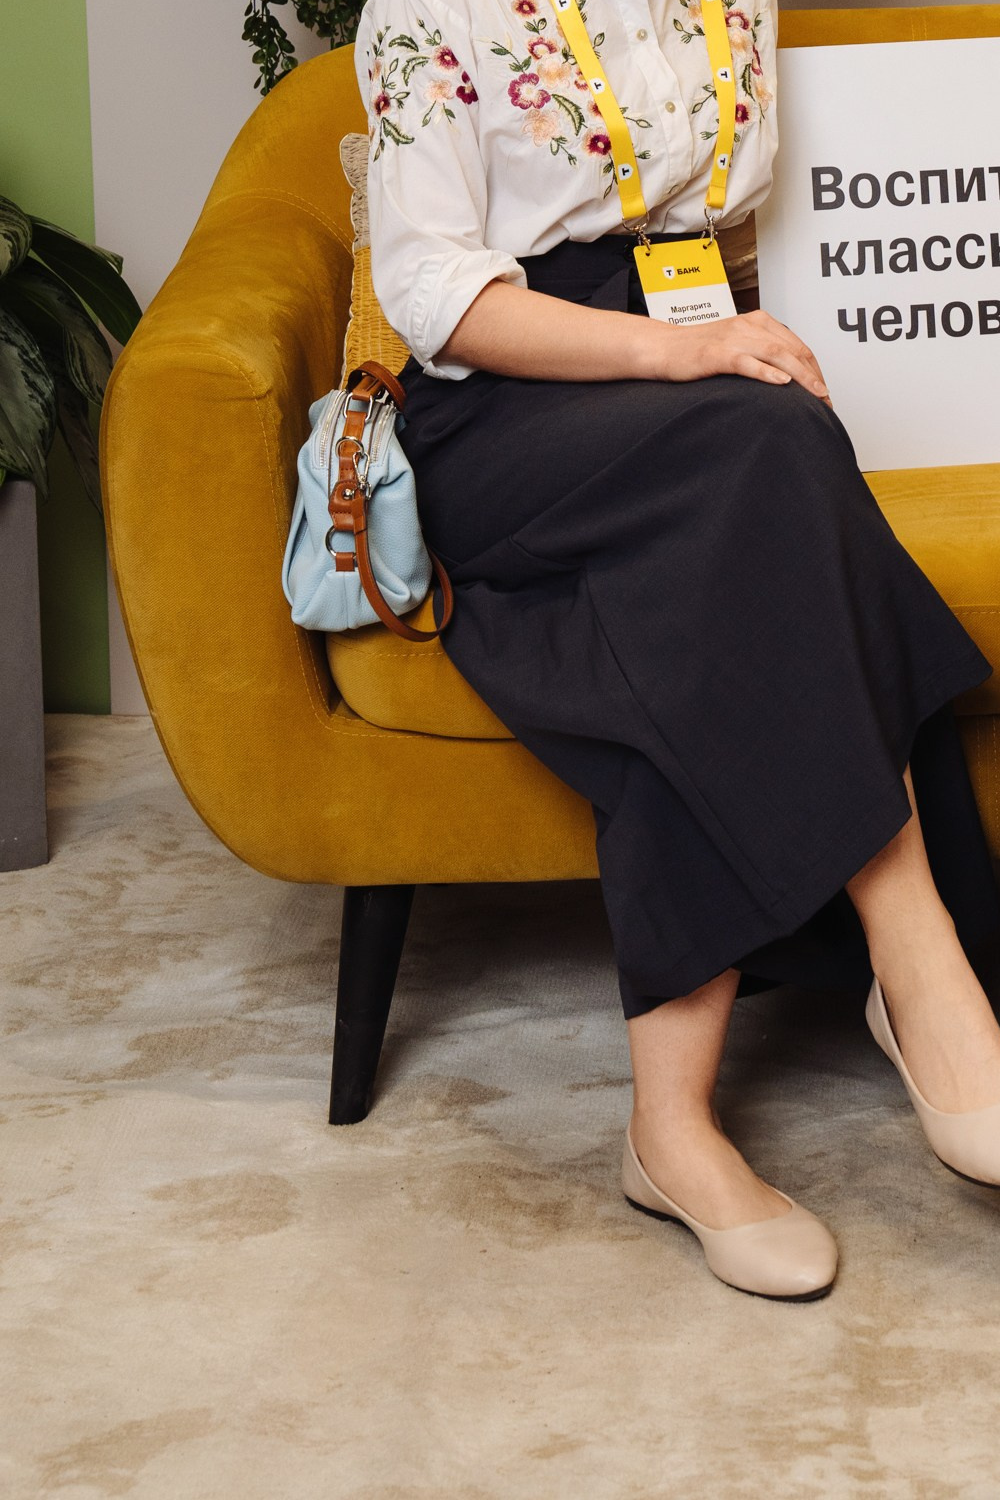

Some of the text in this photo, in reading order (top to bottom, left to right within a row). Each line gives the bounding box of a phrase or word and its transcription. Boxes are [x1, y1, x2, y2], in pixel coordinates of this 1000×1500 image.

[677, 266, 701, 275] БАНК
[670, 302, 712, 314] Маргарита
[668, 311, 720, 324] Протопопова
